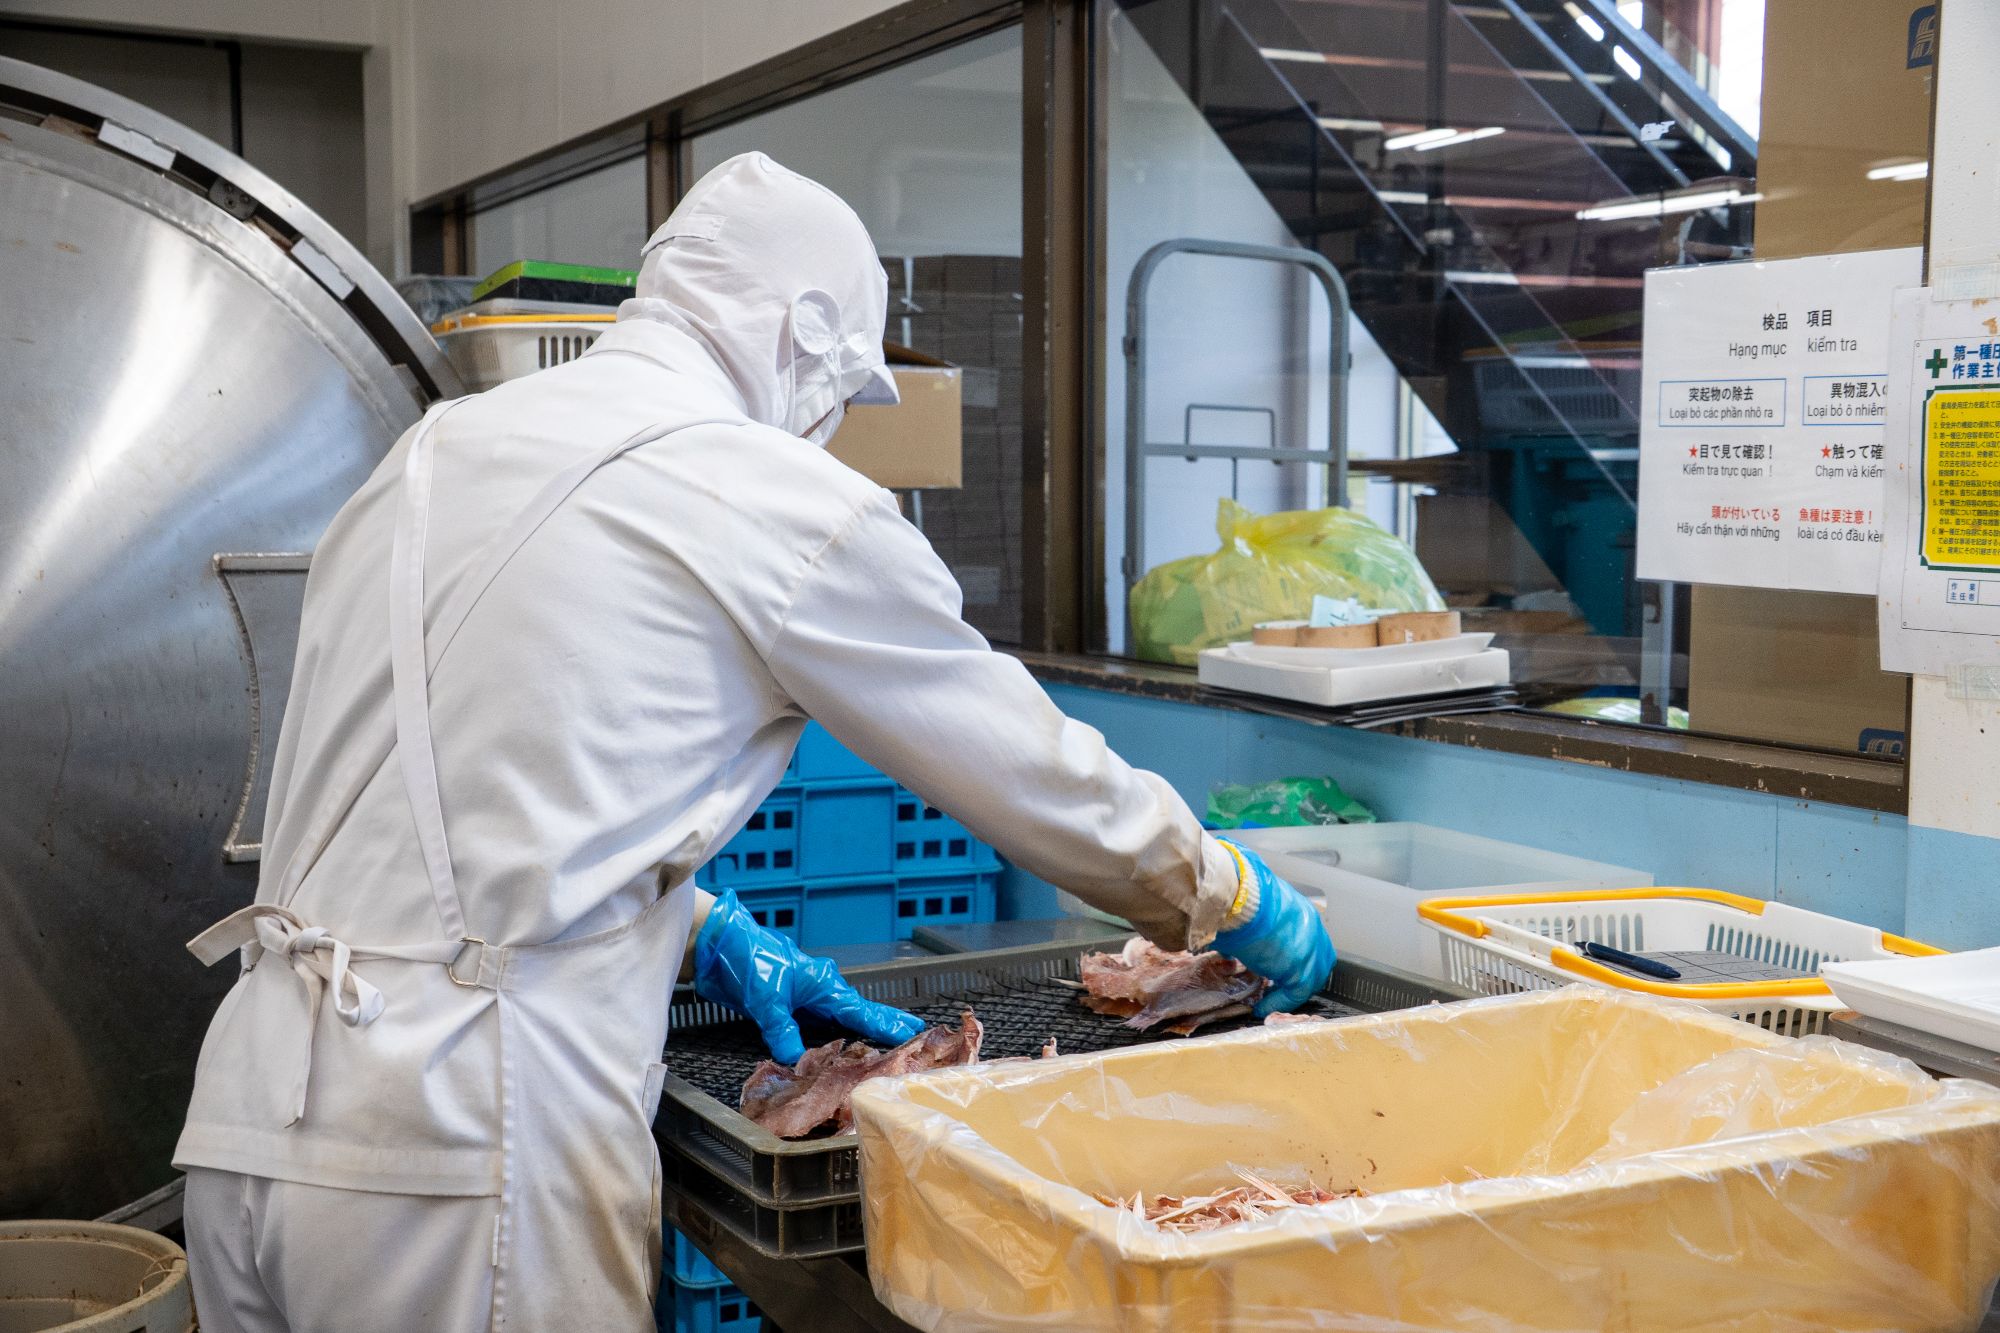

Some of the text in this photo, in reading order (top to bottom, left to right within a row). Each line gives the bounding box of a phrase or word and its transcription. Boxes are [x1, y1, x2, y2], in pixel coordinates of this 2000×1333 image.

[1762, 309, 1832, 331] 検品 項目
[1729, 343, 1758, 359] Hạng
[1761, 343, 1787, 358] mục
[1840, 338, 1857, 351] tra
[1952, 362, 2000, 379] 作業主
[1688, 386, 1754, 402] 突起物の除去
[1669, 407, 1688, 420] Loại
[1703, 407, 1719, 419] các
[1764, 410, 1773, 418] ra
[1807, 405, 1828, 419] Loại
[1699, 444, 1773, 460] 目で見て確認！
[1707, 465, 1719, 476] tra
[1815, 465, 1844, 479] Chạm
[1846, 465, 1858, 478] và
[1711, 505, 1872, 525] 頭が付いている 魚種は要注意！
[1816, 528, 1828, 540] cá
[1830, 529, 1843, 541] có
